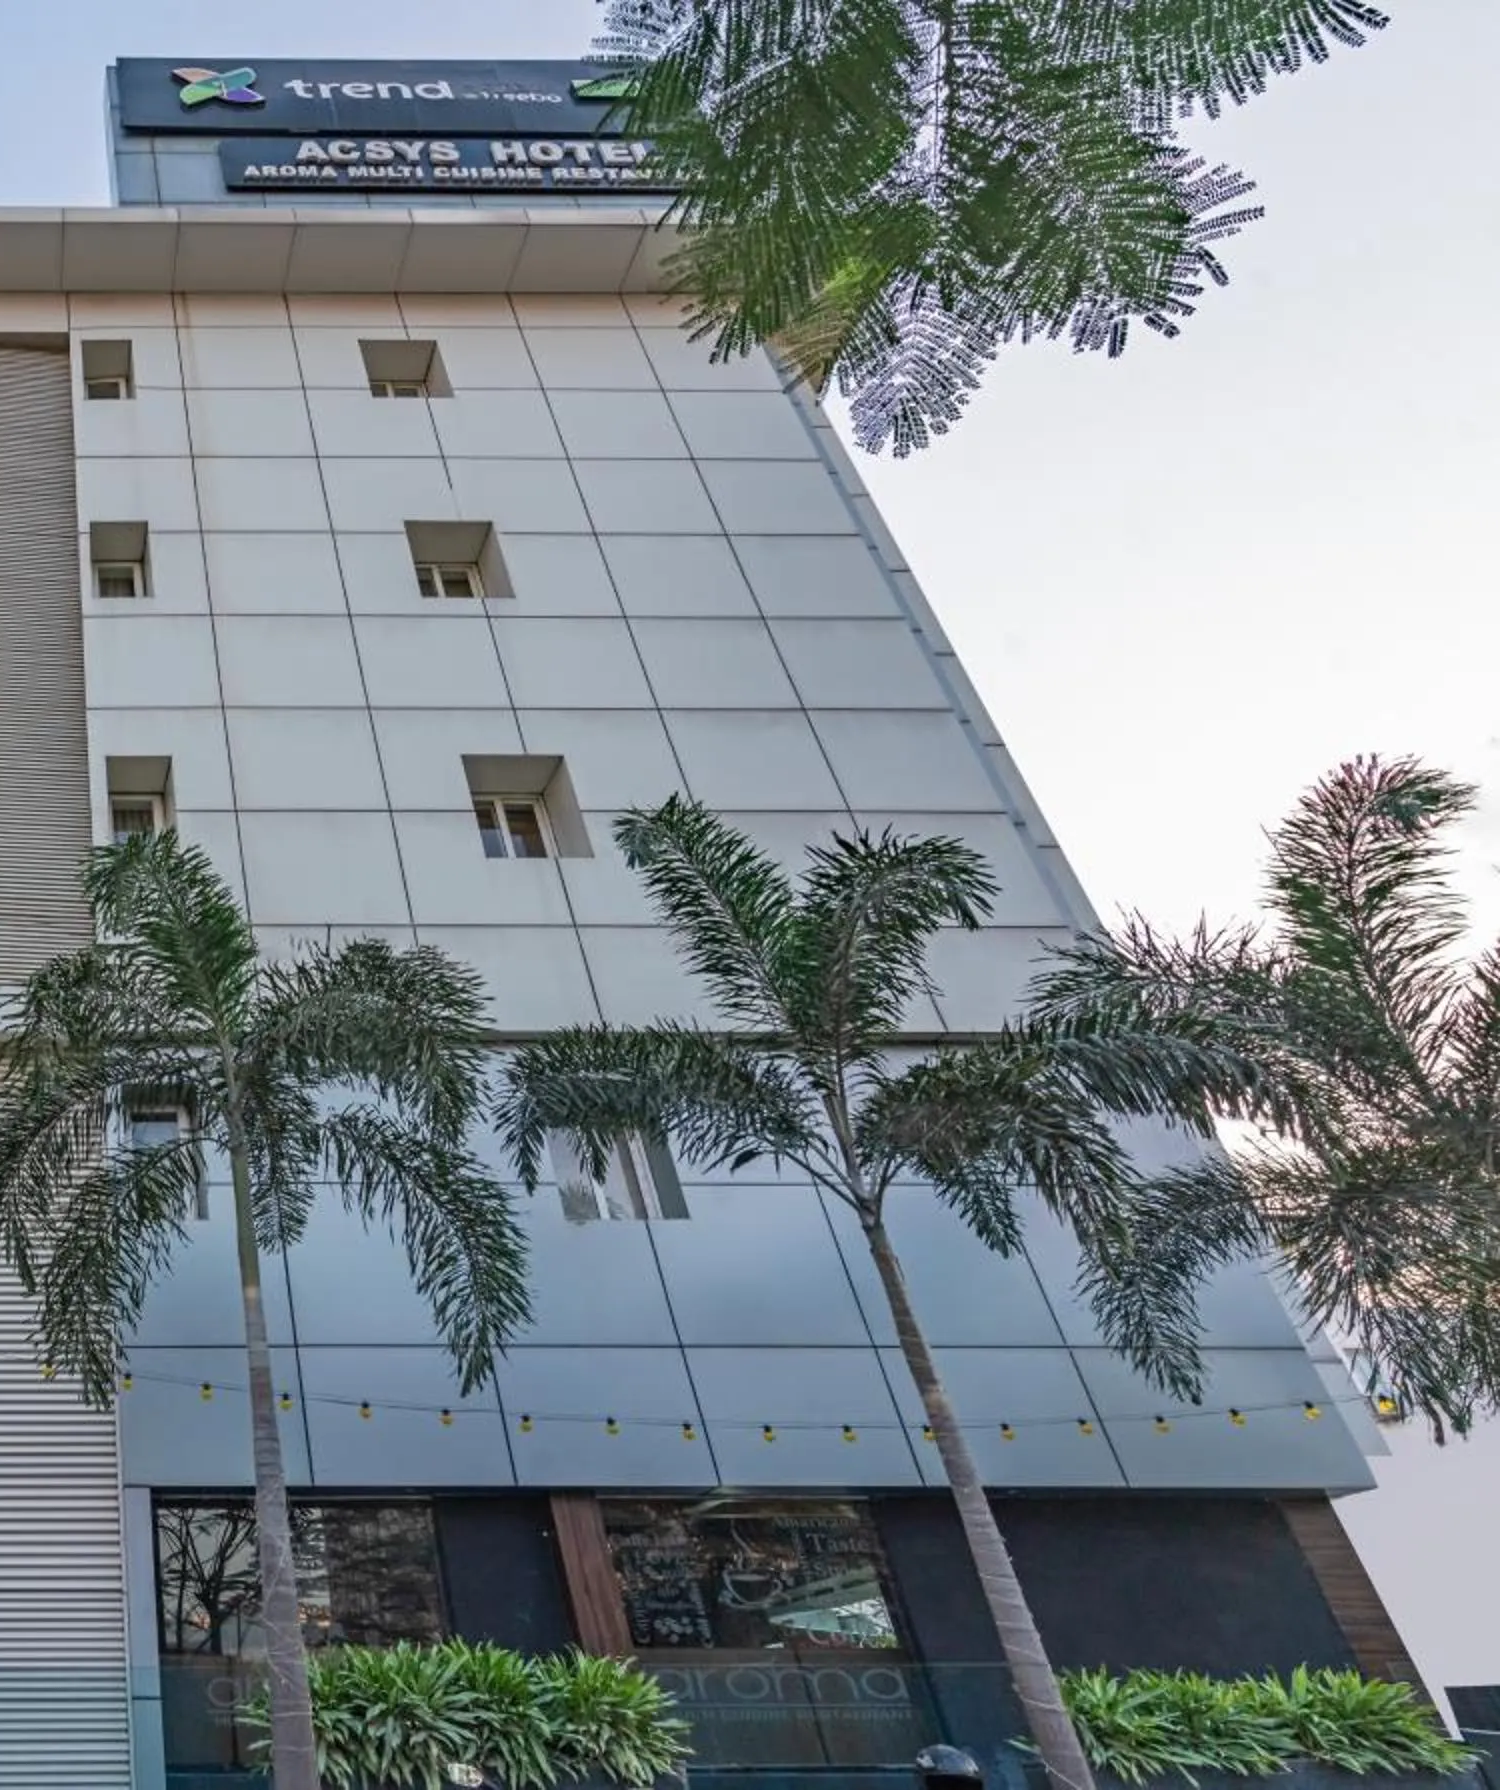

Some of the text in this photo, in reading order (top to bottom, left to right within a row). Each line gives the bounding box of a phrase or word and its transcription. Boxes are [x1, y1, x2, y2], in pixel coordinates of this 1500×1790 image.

[284, 79, 455, 99] trend
[296, 140, 461, 163] ACSYS
[244, 165, 338, 177] AROMA
[347, 165, 424, 178] MULTI
[433, 166, 543, 180] CUISINE
